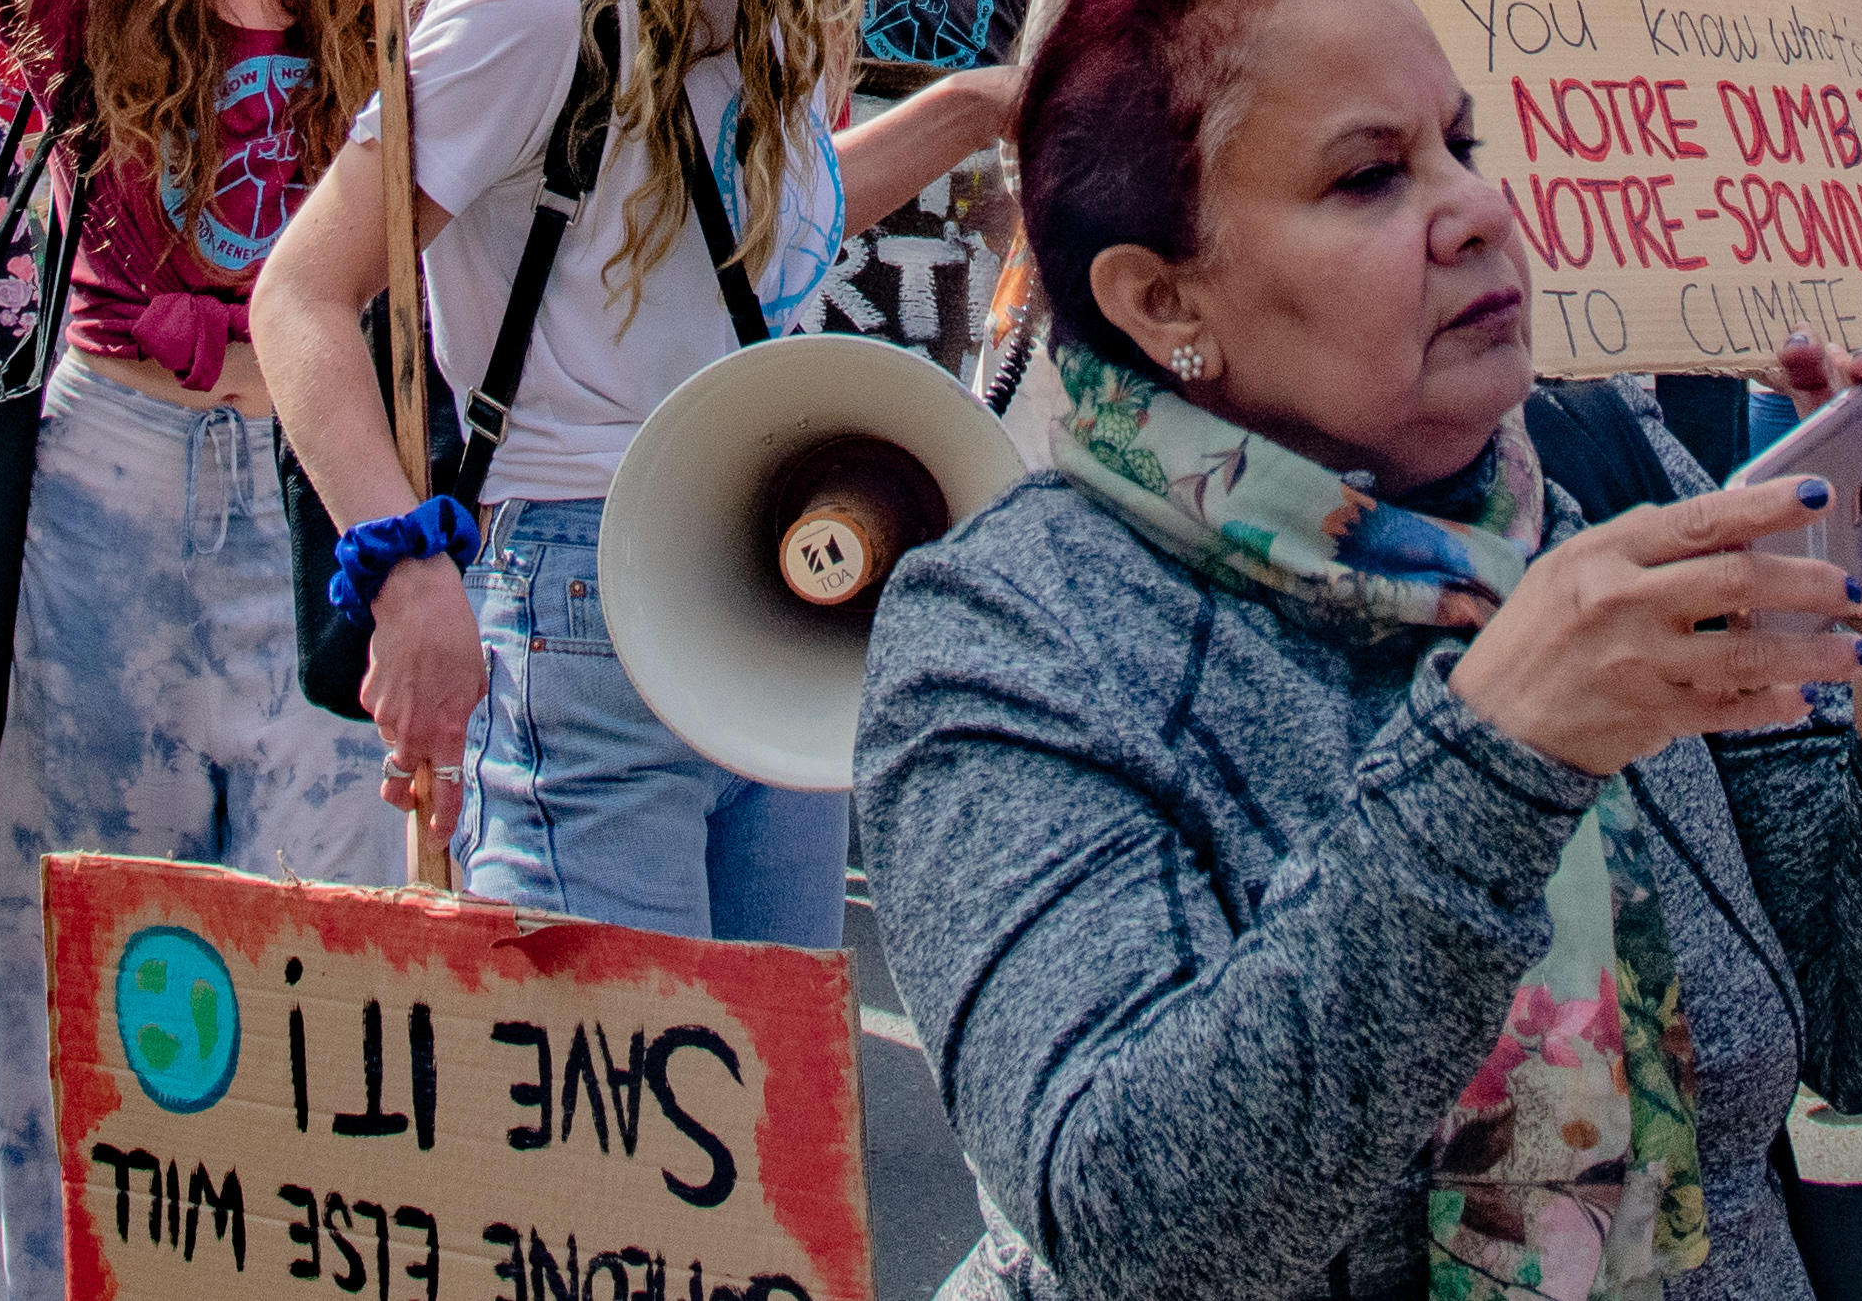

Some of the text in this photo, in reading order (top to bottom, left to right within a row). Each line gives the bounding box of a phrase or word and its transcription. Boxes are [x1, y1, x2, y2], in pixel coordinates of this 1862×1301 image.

[1511, 75, 1709, 164] NOTRE
[1543, 289, 1628, 359] TO
[1681, 277, 1858, 357] CLIMATE
[816, 567, 855, 594] TOA
[284, 955, 745, 1209] SAVE IT!
[276, 1182, 440, 1301] ELSE
